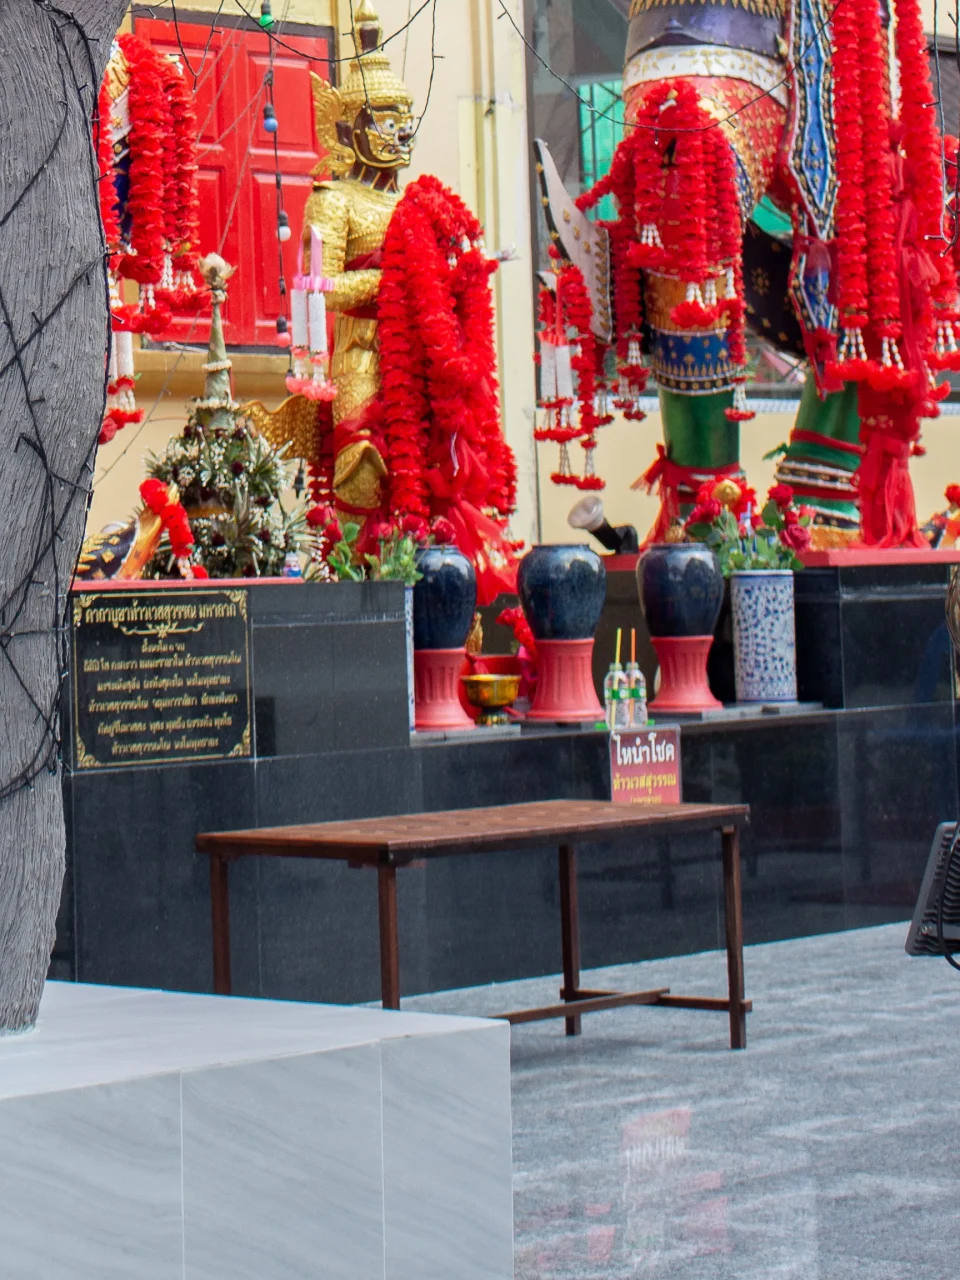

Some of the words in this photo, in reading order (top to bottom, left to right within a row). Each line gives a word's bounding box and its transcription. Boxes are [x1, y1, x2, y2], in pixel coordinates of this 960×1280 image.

[85, 600, 196, 628] คาถาบูชาท้าวเวสสุวรรณ
[612, 732, 675, 766] ไหนำโชค
[613, 771, 676, 794] ท้าวเวสสุวรรณ
